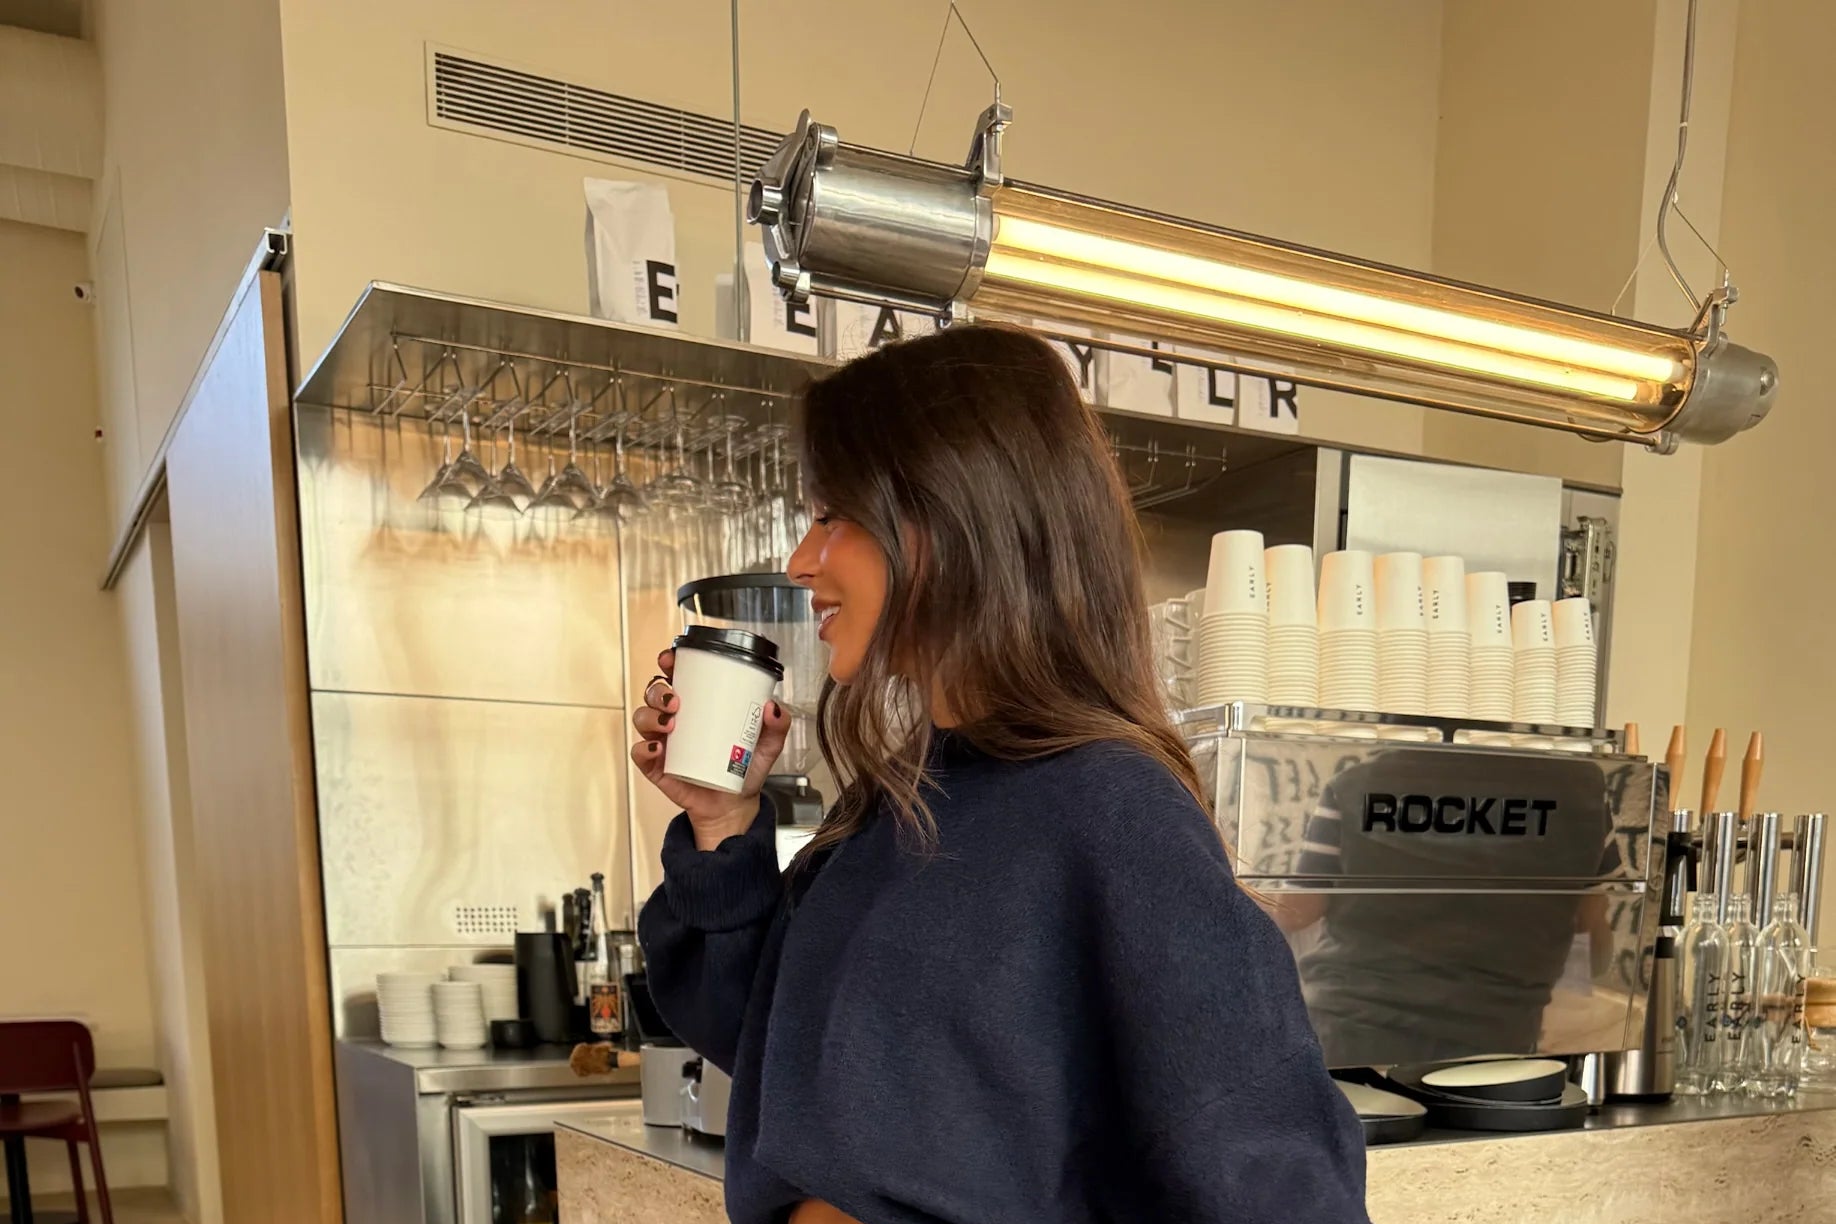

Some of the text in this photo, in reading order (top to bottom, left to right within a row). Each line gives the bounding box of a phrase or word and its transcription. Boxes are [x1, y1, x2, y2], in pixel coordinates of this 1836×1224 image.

[646, 259, 678, 324] E
[1268, 379, 1298, 419] R
[1432, 590, 1440, 620] EARLY
[1541, 613, 1549, 642] EARLY
[1362, 793, 1558, 837] ROCKET
[1704, 972, 1721, 1042] EARLY
[1727, 972, 1746, 1041] EARLY
[1791, 974, 1807, 1044] EARLY
